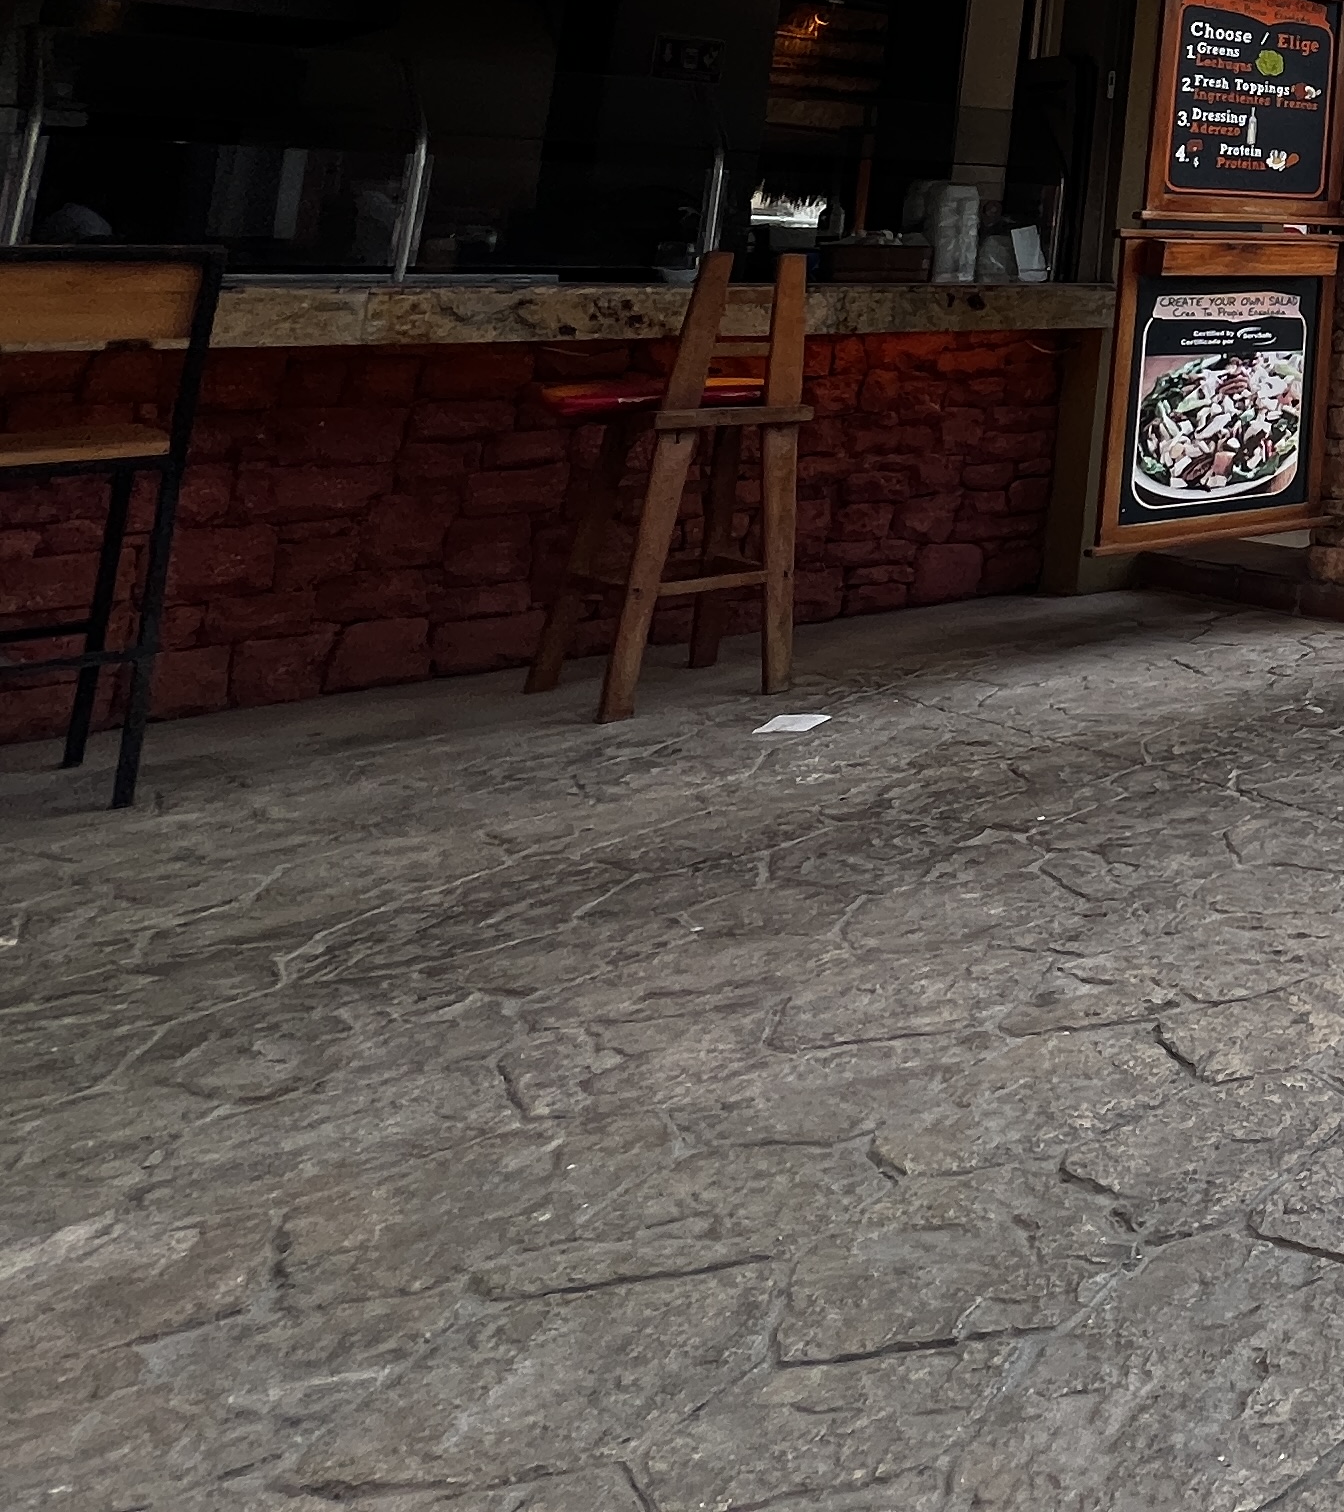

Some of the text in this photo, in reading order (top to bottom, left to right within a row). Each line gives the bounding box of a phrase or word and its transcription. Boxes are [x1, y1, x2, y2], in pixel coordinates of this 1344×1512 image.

[1190, 21, 1252, 44] Choose
[1277, 33, 1320, 56] Elige
[1197, 41, 1240, 58] Greens
[1181, 74, 1290, 98] 2. Fresh Toppings
[1177, 107, 1247, 127] 3. Dressing
[1190, 122, 1242, 136] Aderezo
[1175, 143, 1262, 162] 4. Protein
[1159, 295, 1298, 307] CREATE YOUR OWN SALAD
[1172, 308, 1196, 318] Crea
[1193, 330, 1235, 338] Certified by
[1222, 338, 1235, 346] por
